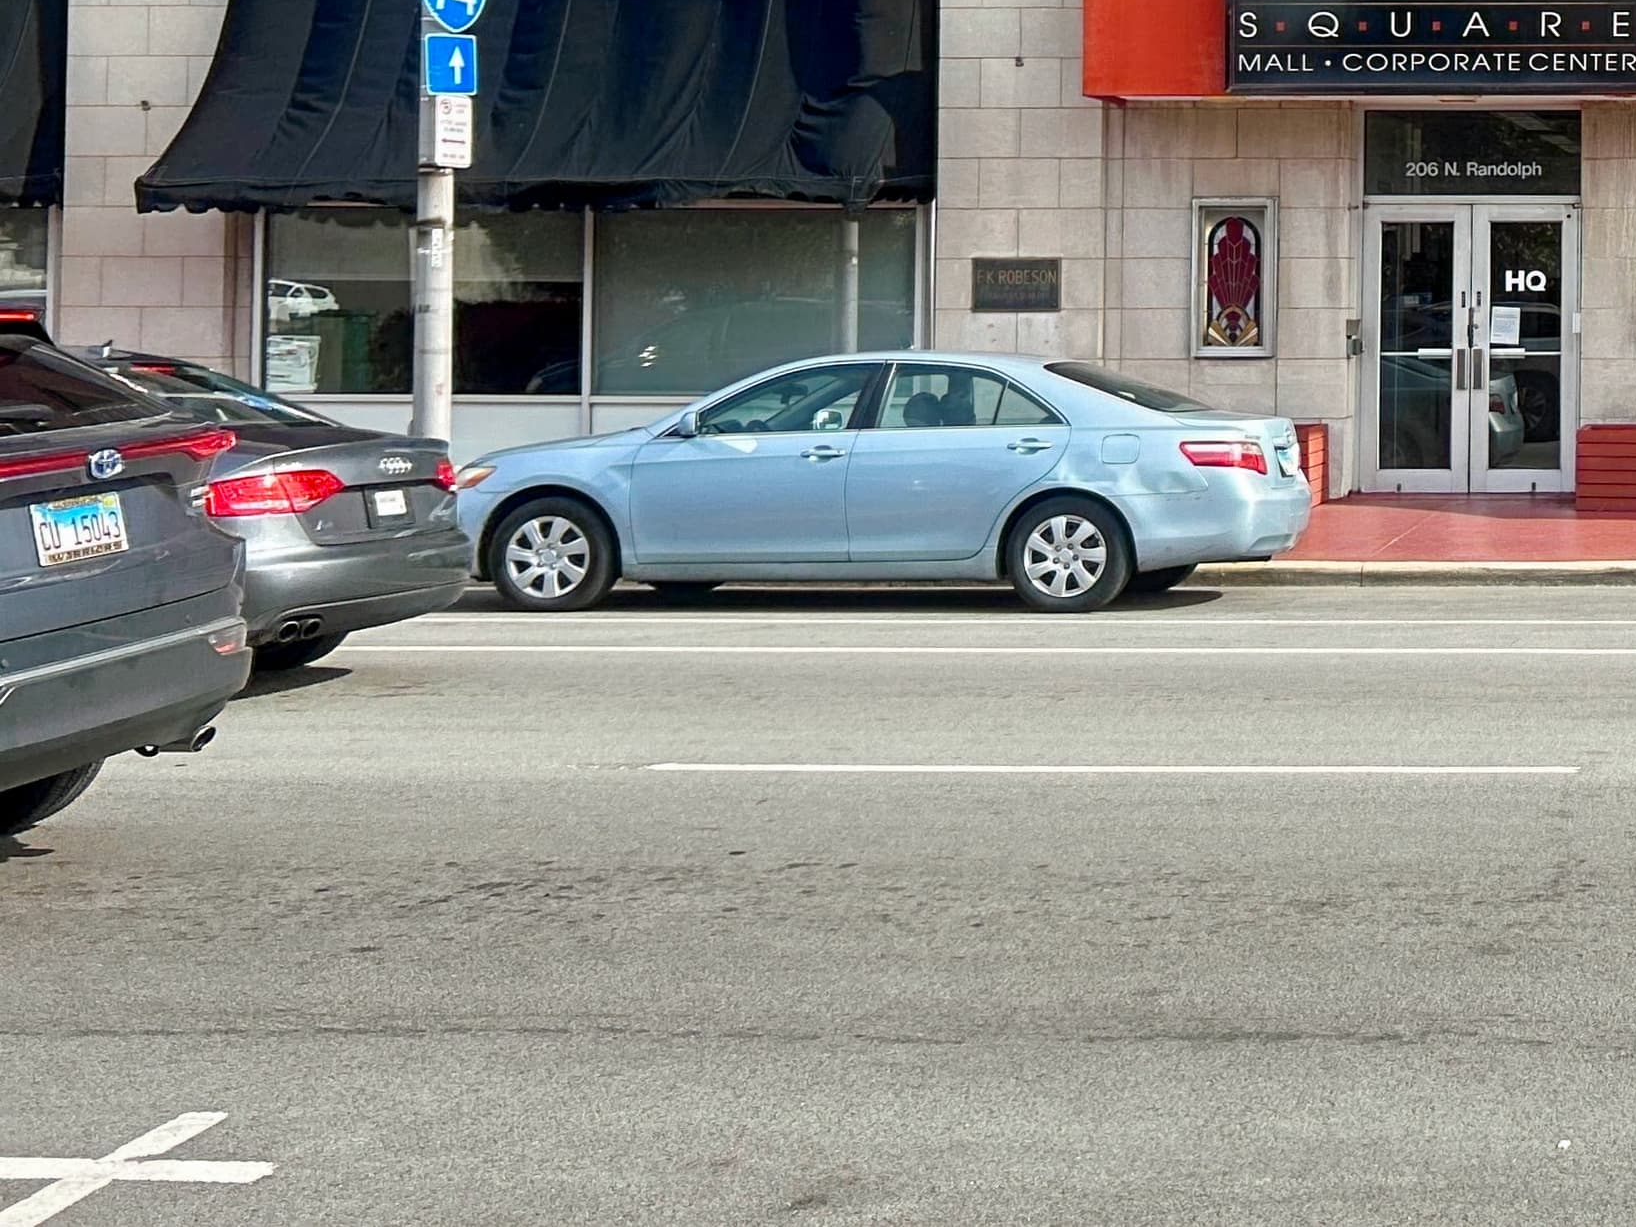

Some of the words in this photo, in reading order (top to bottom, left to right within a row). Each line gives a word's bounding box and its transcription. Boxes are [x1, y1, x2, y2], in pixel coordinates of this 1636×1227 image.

[1238, 53, 1314, 72] MALL
[1342, 52, 1521, 72] CORPORATE
[1528, 52, 1636, 72] CENTER
[1405, 161, 1439, 177] 206
[1444, 161, 1460, 177] N.
[1466, 161, 1542, 180] Randolph
[999, 270, 1056, 285] ROBESON
[1505, 270, 1547, 292] HQ
[71, 511, 121, 546] 15043
